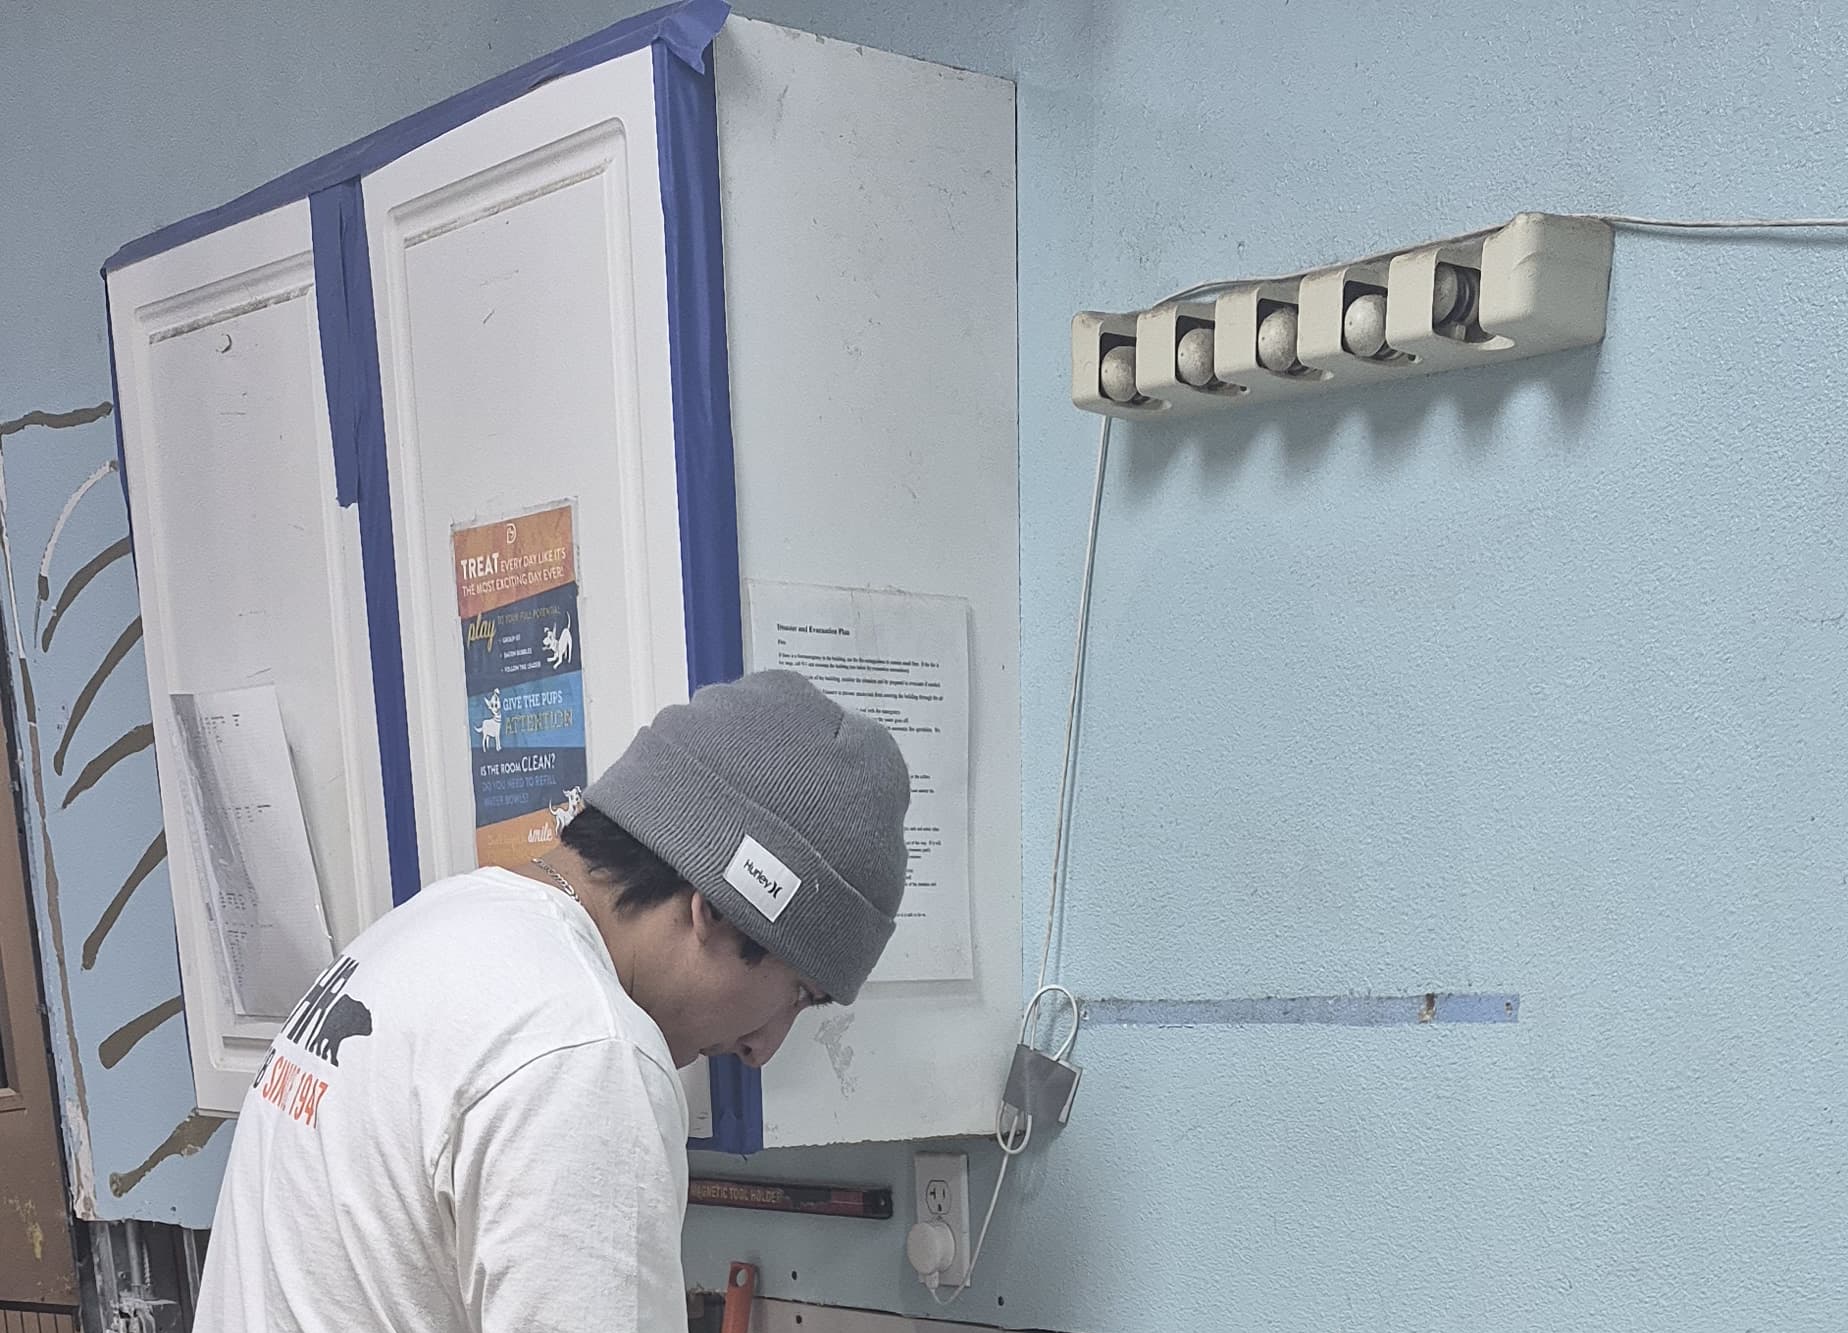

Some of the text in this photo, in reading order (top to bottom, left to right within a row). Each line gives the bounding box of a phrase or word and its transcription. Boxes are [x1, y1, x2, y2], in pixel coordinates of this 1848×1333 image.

[460, 552, 499, 580] TREAT
[501, 557, 522, 572] EVERY
[523, 554, 538, 567] DAY
[538, 549, 553, 564] LIKE
[462, 585, 476, 597] THE
[476, 580, 495, 594] MOST
[496, 573, 528, 590] EXCITING
[528, 570, 543, 585] DAY
[467, 611, 496, 653] play
[798, 625, 808, 633] and
[809, 625, 837, 635] Evacuation
[838, 627, 850, 636] Plan
[503, 690, 563, 712] GIVE THE PUPS
[505, 708, 573, 736] ATTENTION
[480, 752, 556, 776] IS THE ROOM CLEAN?
[527, 821, 553, 843] smile
[743, 858, 772, 889] Hurley
[288, 1072, 329, 1129] 1947
[728, 1186, 749, 1201] TOOL
